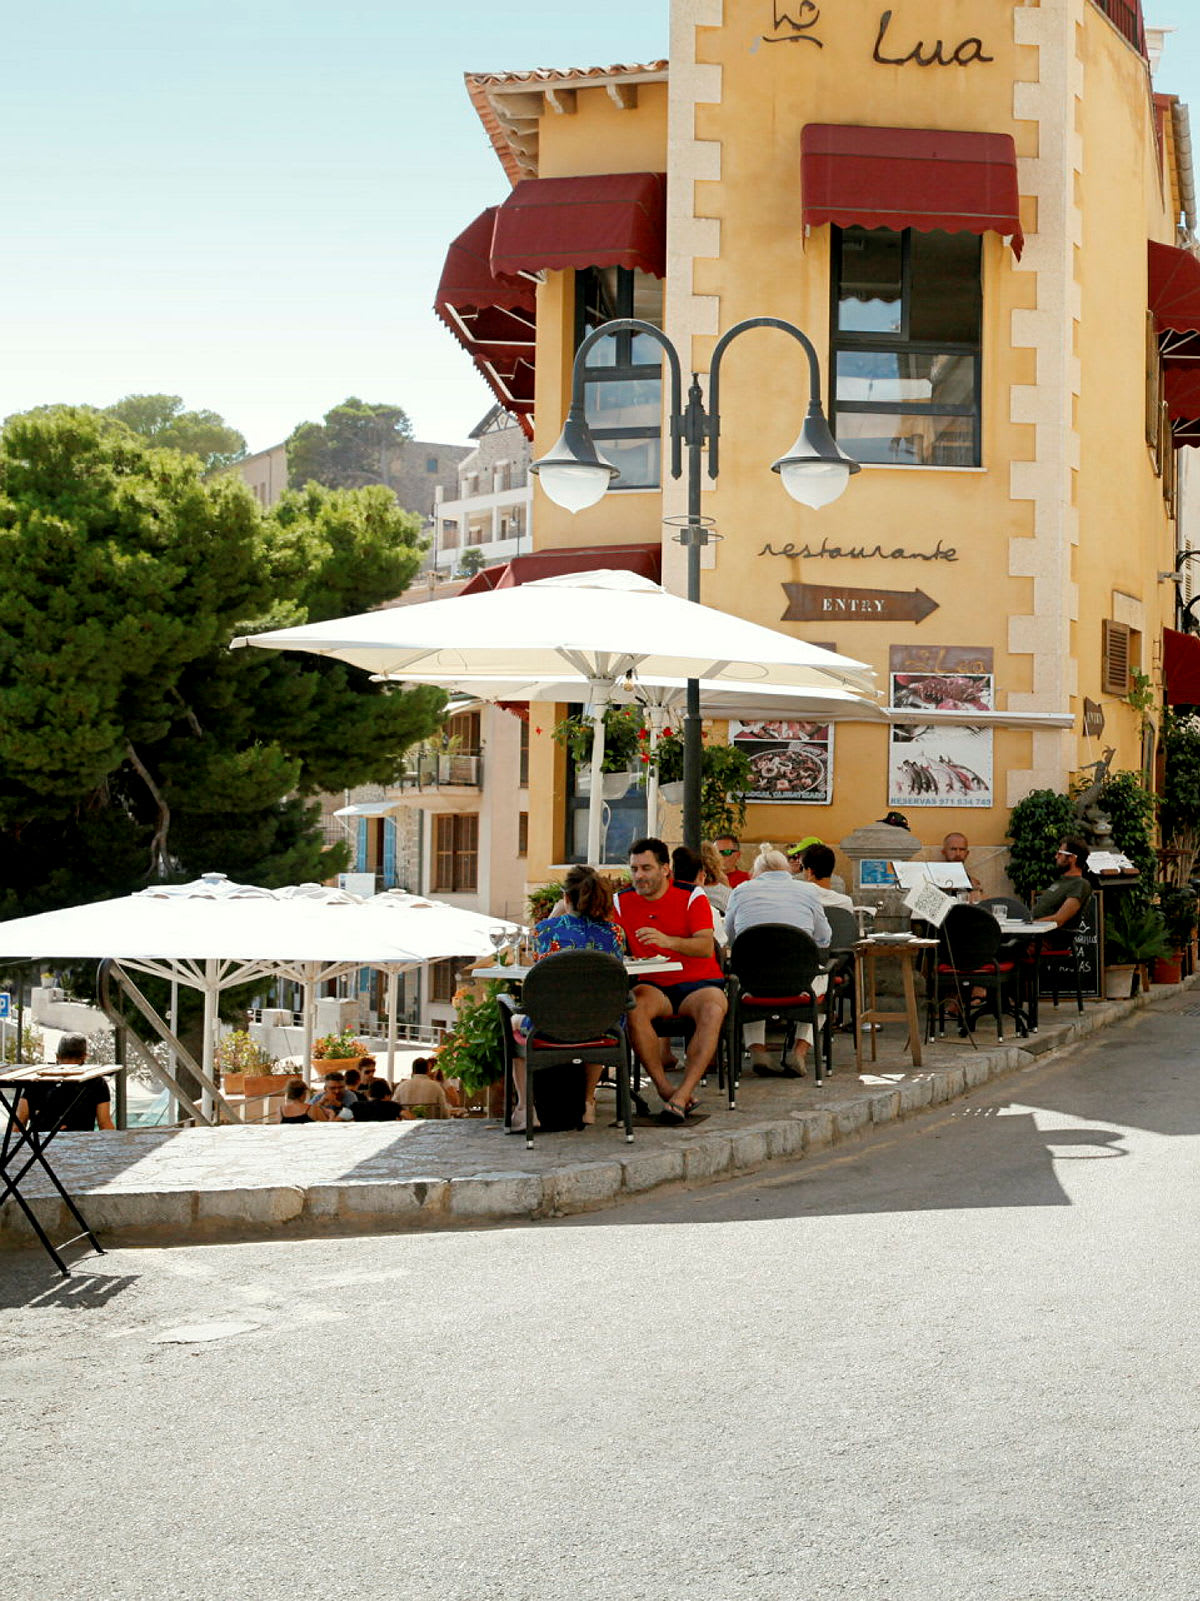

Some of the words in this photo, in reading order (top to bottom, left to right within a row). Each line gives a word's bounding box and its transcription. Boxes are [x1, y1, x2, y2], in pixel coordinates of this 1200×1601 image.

[873, 9, 994, 66] Lua
[757, 537, 959, 562] restaurante
[823, 597, 885, 612] ENTRY
[891, 797, 937, 805] RESERVAS
